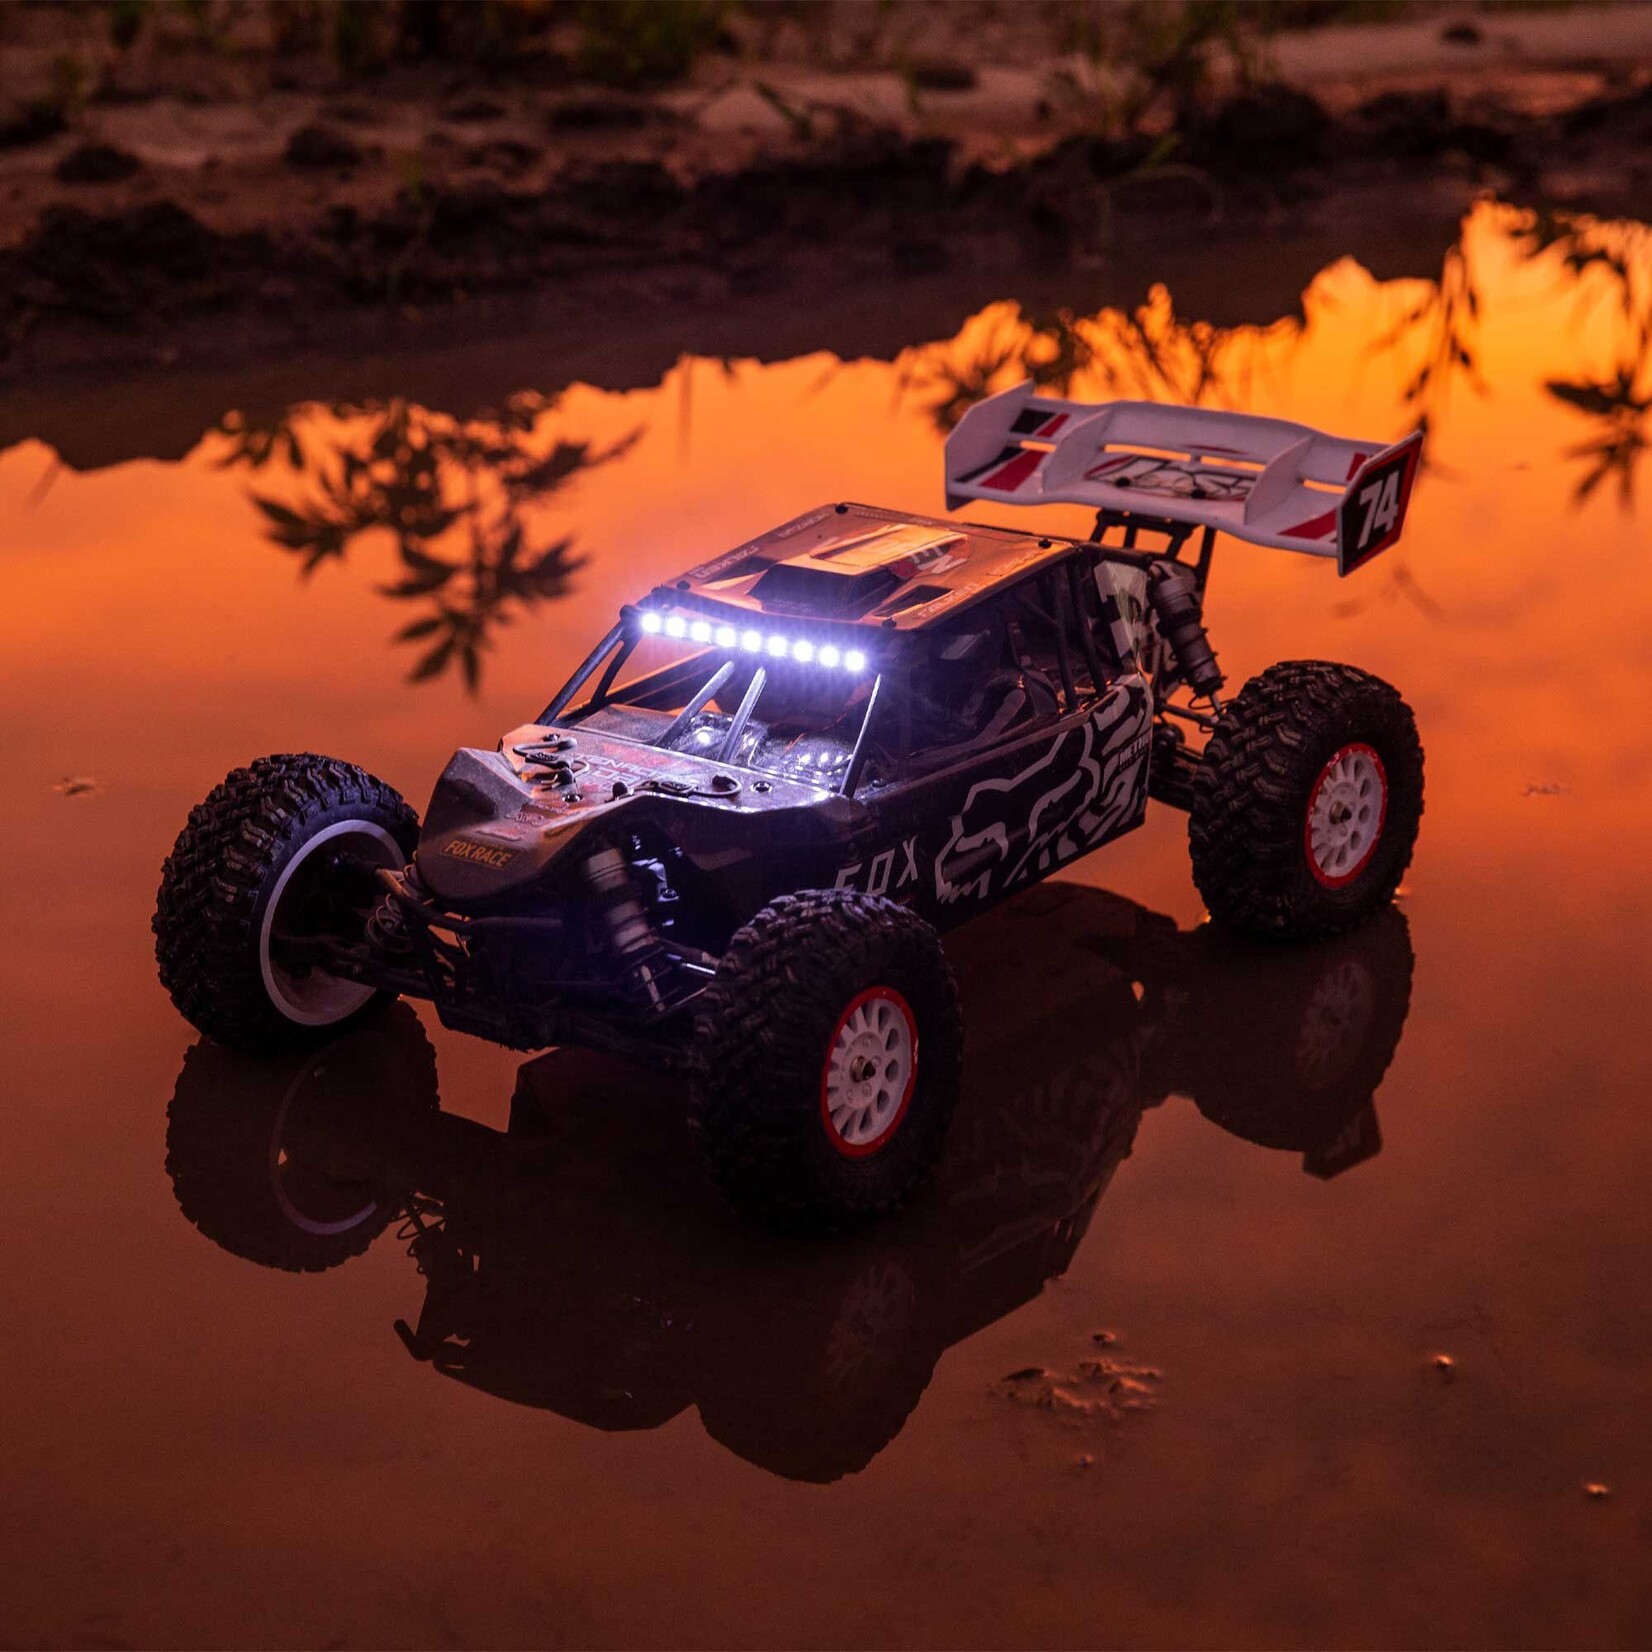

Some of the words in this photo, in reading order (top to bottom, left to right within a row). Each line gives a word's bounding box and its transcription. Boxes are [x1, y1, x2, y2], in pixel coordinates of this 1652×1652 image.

[1357, 470, 1400, 550] 74
[444, 839, 474, 858] FOX
[471, 845, 513, 868] RACE
[834, 836, 921, 897] FOX
